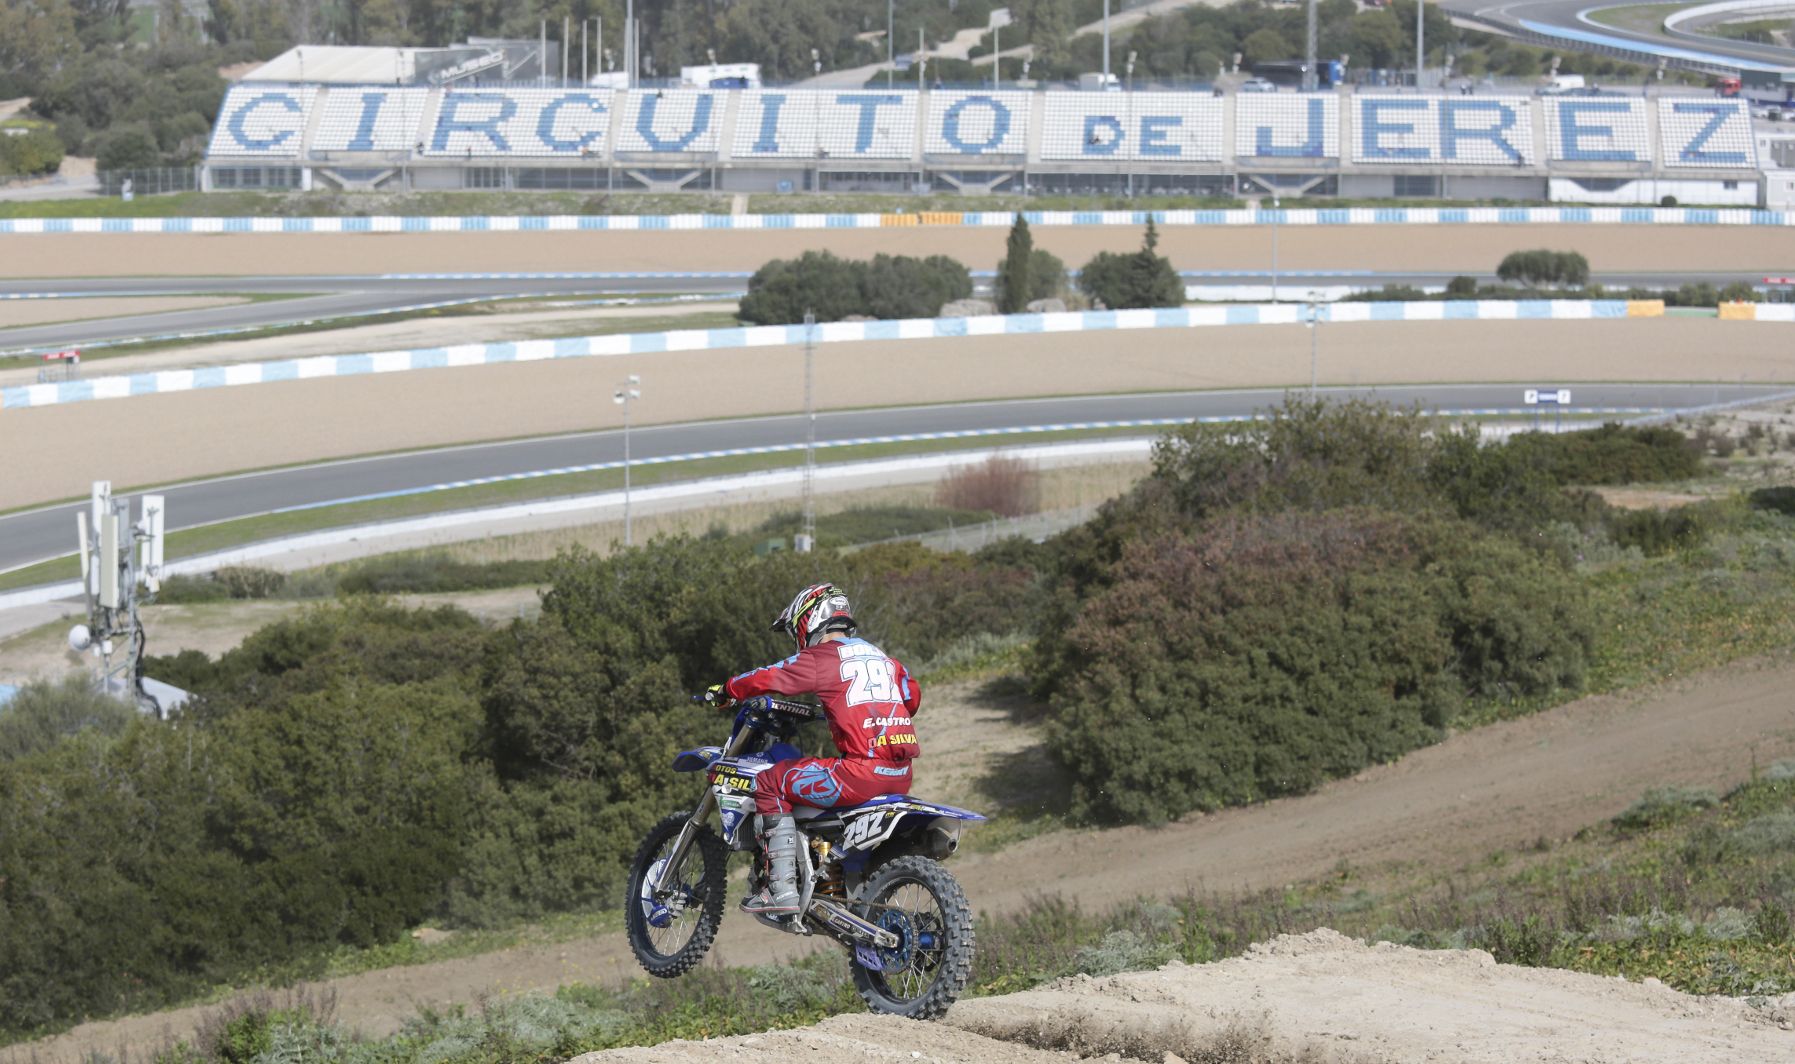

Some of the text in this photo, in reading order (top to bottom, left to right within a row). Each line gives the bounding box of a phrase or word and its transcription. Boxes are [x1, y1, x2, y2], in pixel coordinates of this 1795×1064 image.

[228, 92, 1746, 162] CIRCUITO DE JEREZ
[890, 733, 917, 745] SILVA
[714, 763, 737, 774] OTOS
[729, 777, 751, 790] SIL
[843, 811, 887, 849] 292
